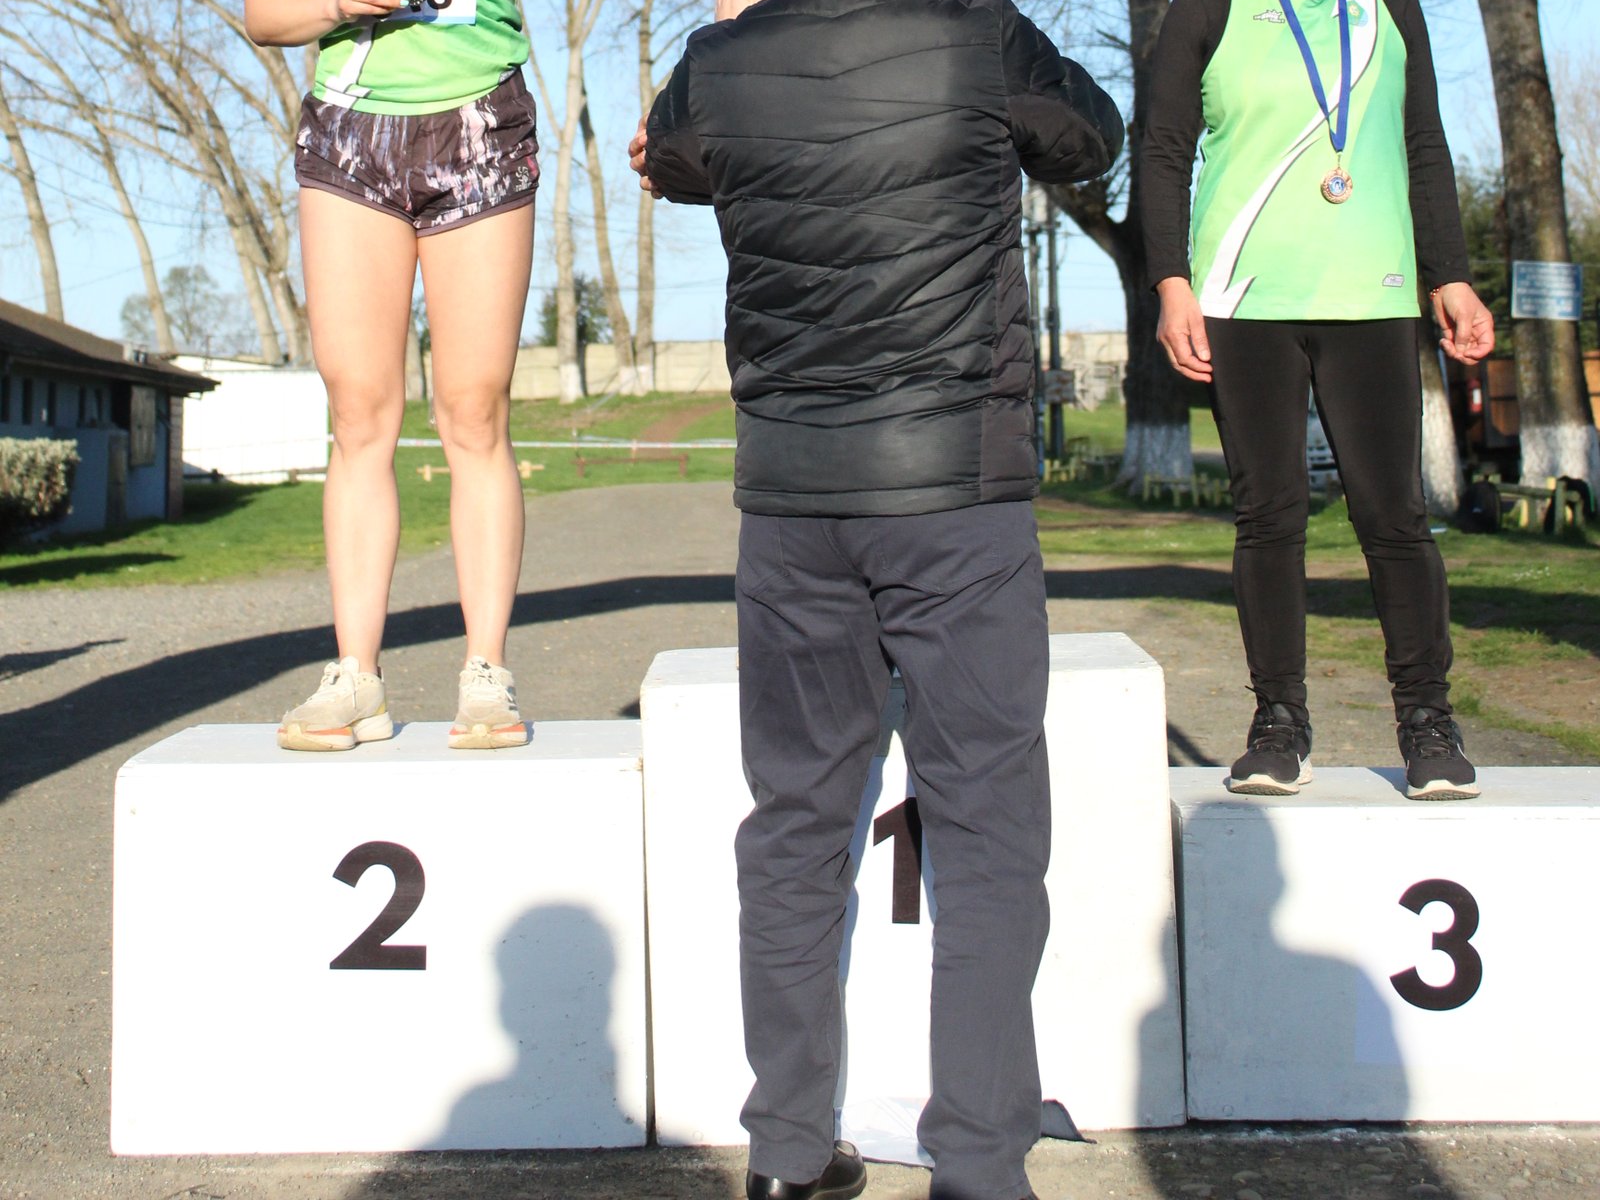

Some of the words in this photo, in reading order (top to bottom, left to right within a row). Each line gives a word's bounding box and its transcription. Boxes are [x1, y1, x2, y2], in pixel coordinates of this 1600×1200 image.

[330, 841, 426, 970] 2
[873, 797, 922, 924] 1
[1390, 878, 1482, 1011] 3
